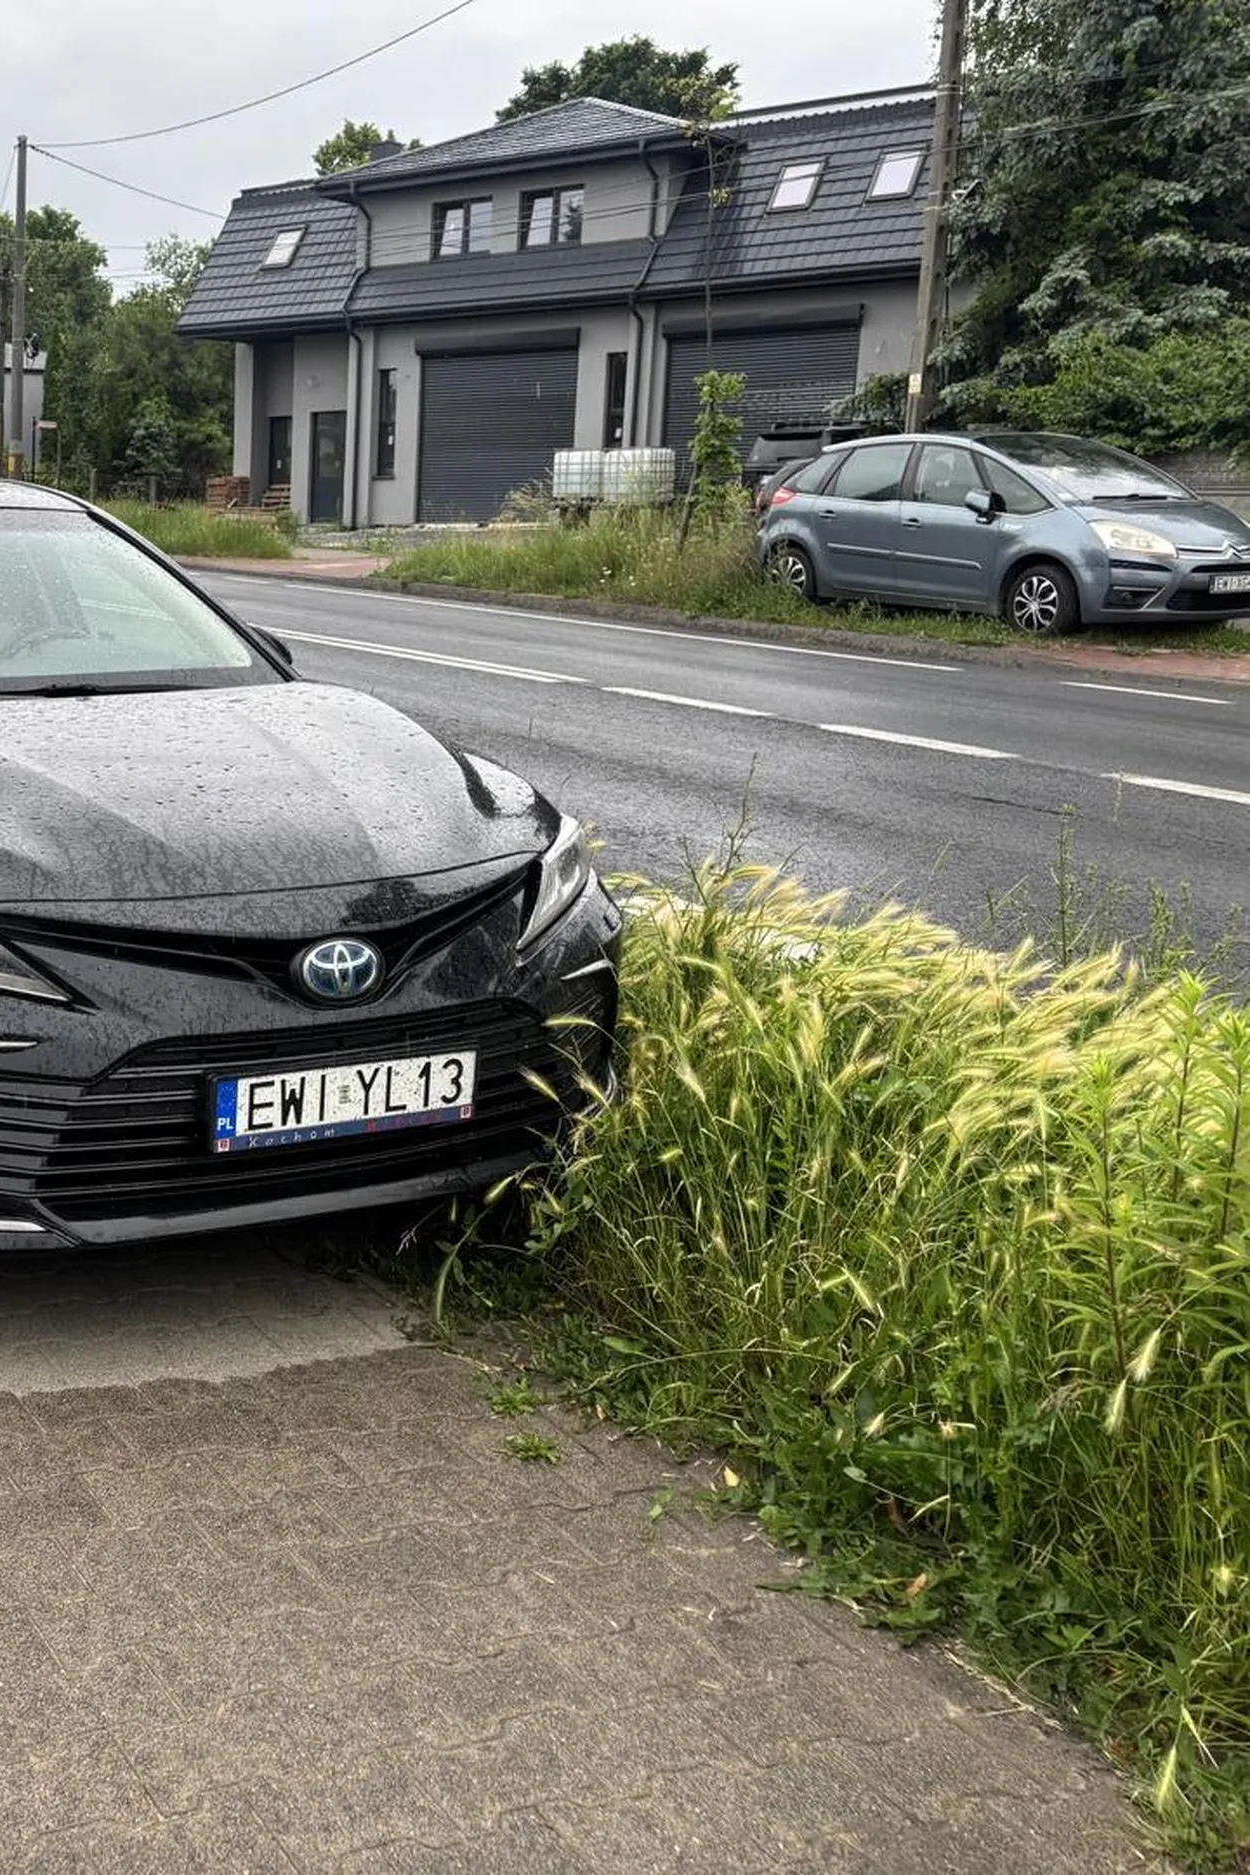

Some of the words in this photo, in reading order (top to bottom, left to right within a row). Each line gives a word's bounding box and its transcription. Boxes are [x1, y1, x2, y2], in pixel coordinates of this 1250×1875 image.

[248, 1074, 326, 1130] EWI
[357, 1058, 464, 1115] YL13
[217, 1117, 233, 1131] PL
